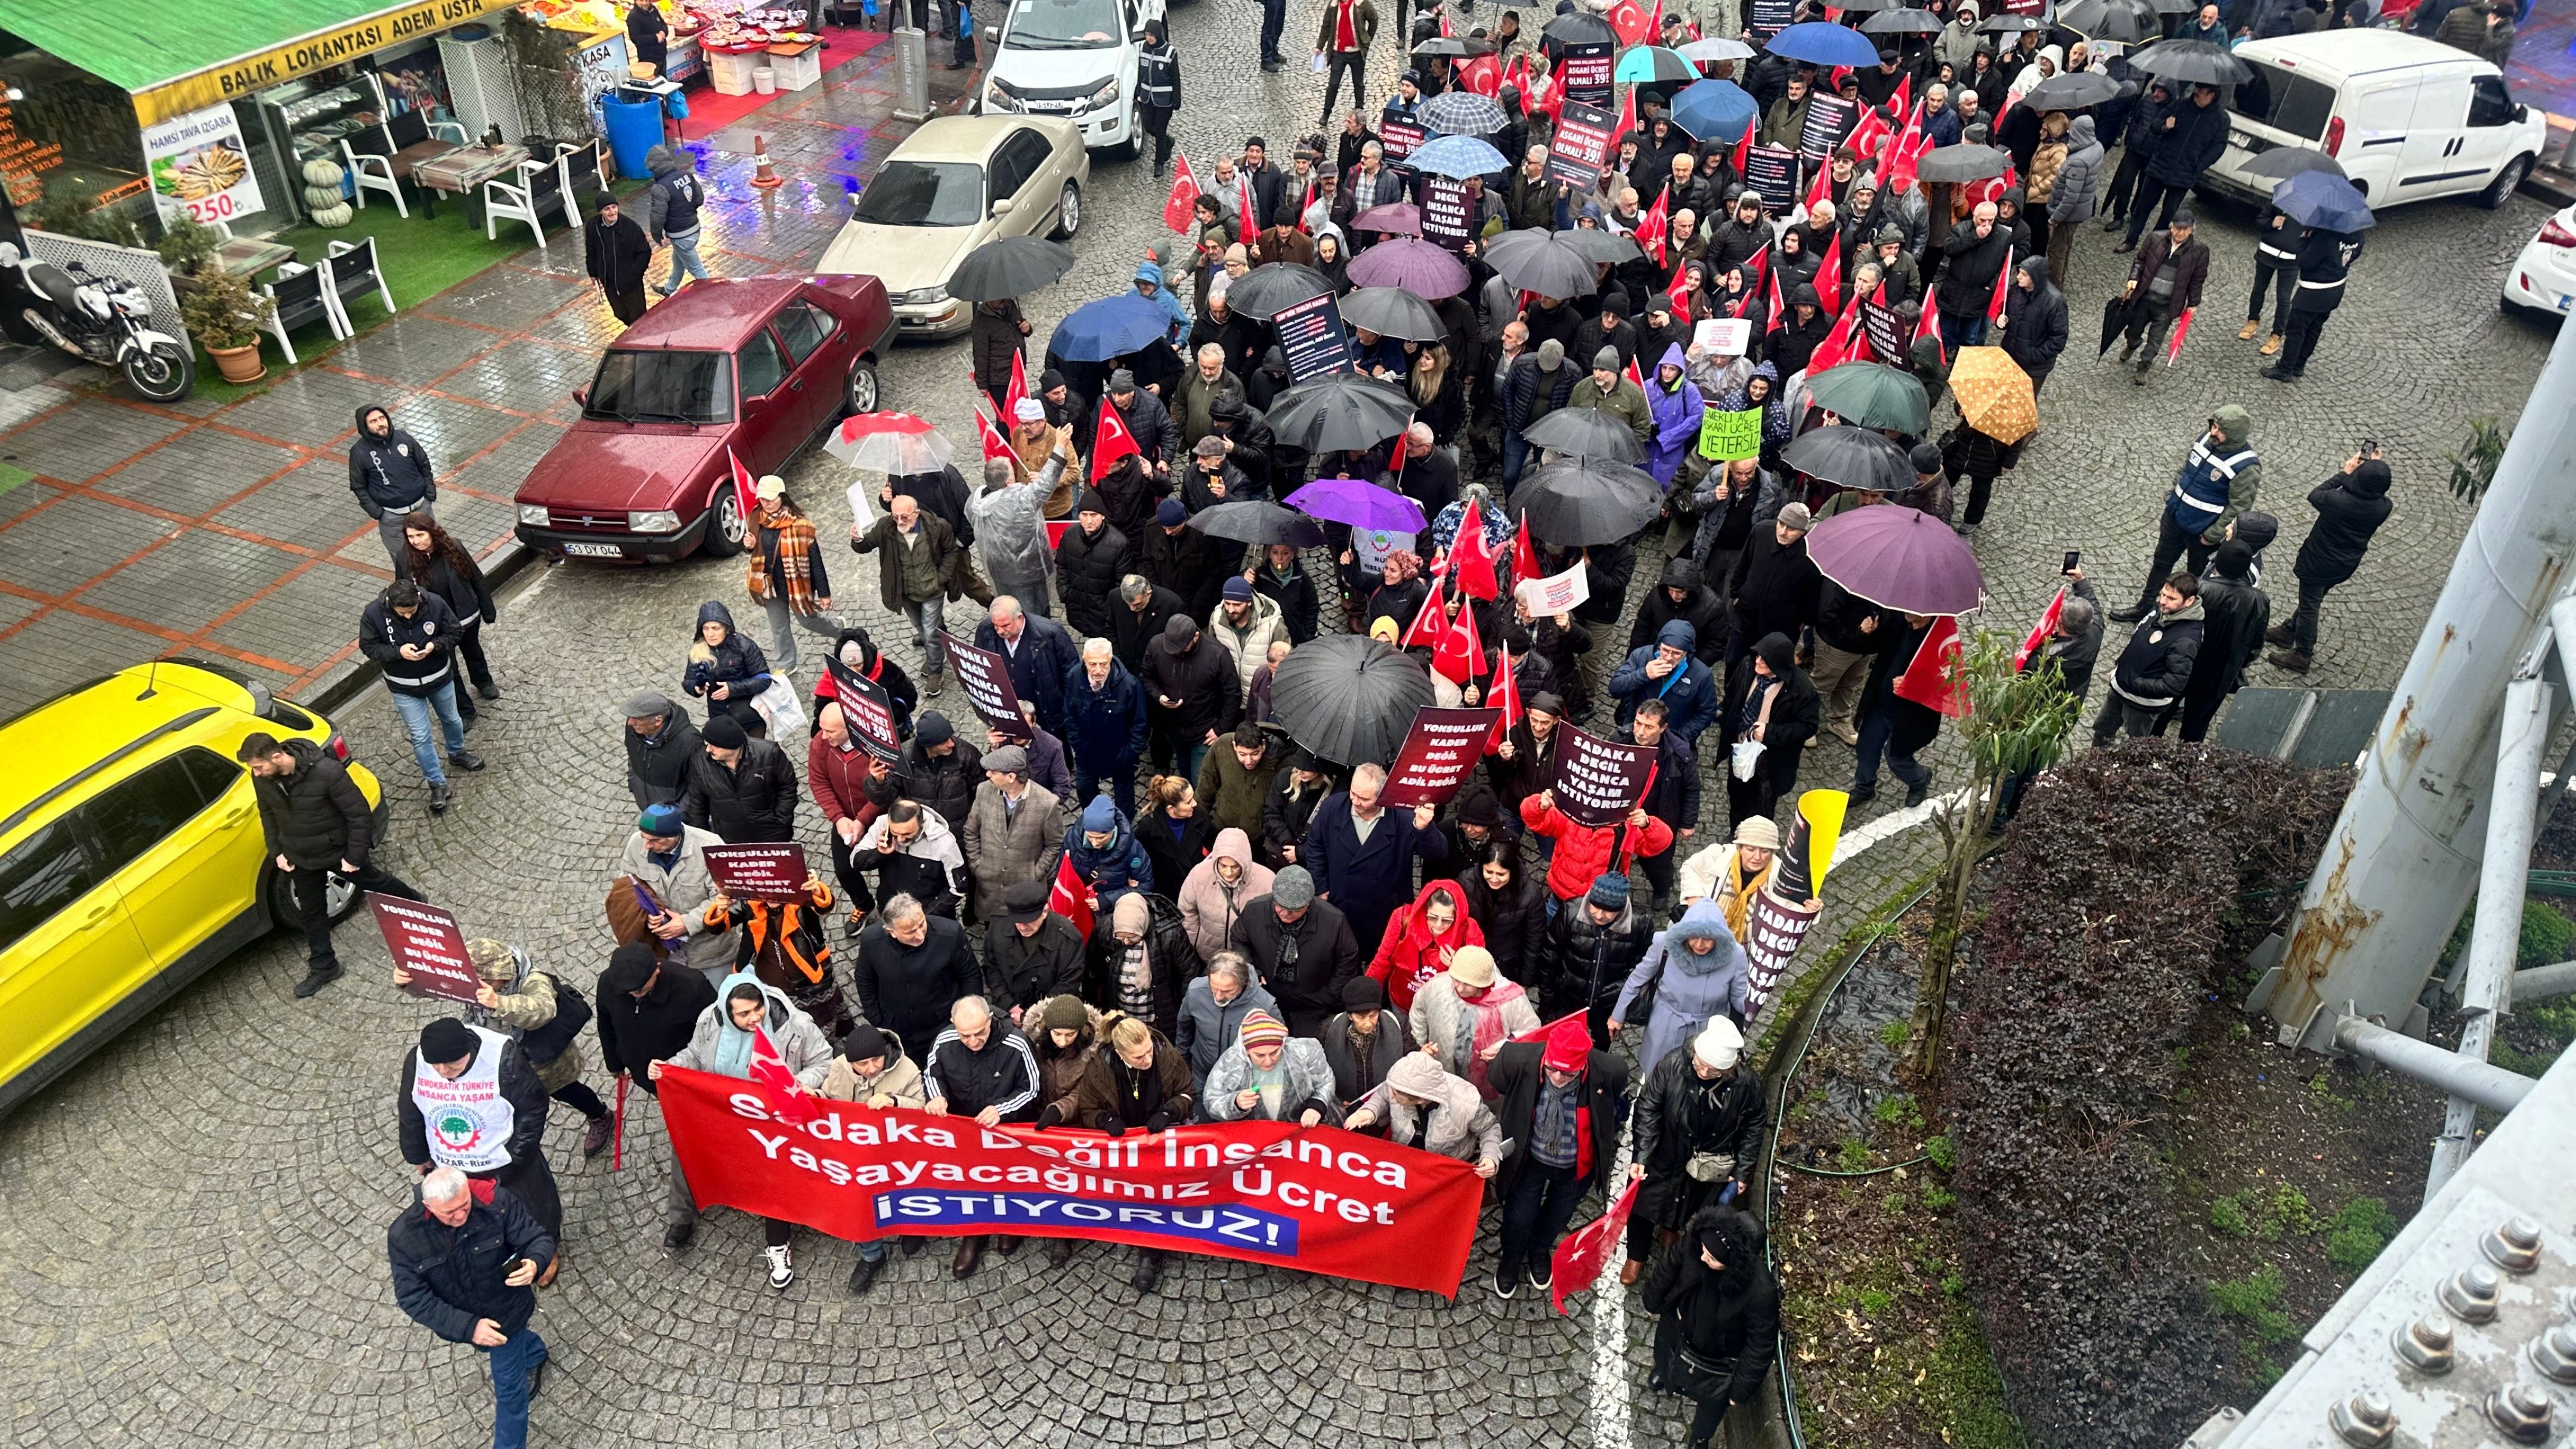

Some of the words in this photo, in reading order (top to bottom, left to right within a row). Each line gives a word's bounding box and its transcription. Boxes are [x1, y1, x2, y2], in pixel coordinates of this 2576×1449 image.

[219, 60, 278, 94] BALIK
[286, 26, 382, 72] LOKANTASI
[392, 9, 436, 38] ADEM
[442, 0, 482, 20] USTA
[581, 45, 611, 67] KASA
[1568, 66, 1590, 75] ASGARİ
[1590, 65, 1609, 73] ÜCRET
[1568, 77, 1593, 85] OLMALI
[1594, 74, 1609, 84] 39!
[1587, 113, 1602, 122] CHP
[150, 129, 180, 149] HAMSİ
[179, 126, 201, 140] TAVA
[201, 114, 232, 134] IZGARA
[1385, 132, 1403, 143] ASGARİ
[1404, 134, 1420, 145] ÜCRET
[1559, 129, 1584, 144] ASGARİ
[1584, 136, 1605, 150] ÜCRET
[1384, 142, 1404, 154] OLMALI
[1555, 142, 1583, 158] OLMALI
[1583, 147, 1602, 164] 39!
[1429, 179, 1467, 194] SADAKA
[187, 194, 234, 224] 250
[1427, 200, 1466, 216] İNSANCA
[1422, 220, 1468, 237] İSTİYORUZ
[1430, 213, 1462, 226] YAŞAM
[1865, 303, 1896, 324] SADAKA
[568, 544, 583, 554] 53
[584, 546, 597, 555] DY
[600, 546, 621, 556] 044
[949, 641, 992, 668] SADAKA
[853, 679, 869, 692] CHP
[966, 683, 1003, 707] YAŞAM
[840, 691, 865, 716] ASGARİ
[865, 707, 888, 729] ÜCRET
[843, 705, 871, 734] OLMALI
[871, 722, 893, 745] 39!
[1423, 723, 1487, 733] YOKSULLUK
[1430, 738, 1468, 747] KADER
[1573, 736, 1636, 762] SADAKA
[1425, 750, 1458, 760] DEĞİL
[1580, 753, 1621, 774] DEĞİL
[1409, 764, 1426, 773] BU
[1427, 763, 1463, 774] ÜCRET
[1566, 758, 1630, 787] İNSANCA
[1398, 776, 1426, 787] ADİL
[1427, 776, 1457, 787] DEĞİL
[1571, 775, 1623, 798] YAŞAM
[1557, 779, 1631, 809] İSTİYORUZ
[708, 850, 791, 859] YOKSULLUK
[379, 903, 453, 927] YOKSULLUK
[401, 921, 445, 937] KADER
[1758, 927, 1797, 952] DEĞİL
[408, 936, 446, 951] DEĞİL
[1750, 937, 1791, 970] NSAN
[404, 947, 422, 958] BU
[422, 949, 463, 968] ÜCRET
[407, 961, 435, 974] ADİL
[435, 967, 472, 983] DEĞİL
[1748, 962, 1778, 987] YAŞA
[417, 1077, 460, 1091] DEMOKRATİK
[462, 1079, 494, 1091] TÜRKİYE
[417, 1086, 457, 1102] İNSANCA
[459, 1093, 494, 1103] YAŞAM
[980, 1127, 1138, 1168] Değil
[1165, 1128, 1407, 1190] İnsanca
[747, 1128, 1210, 1200] Yaşayacağımız
[1232, 1163, 1395, 1225] Ücret
